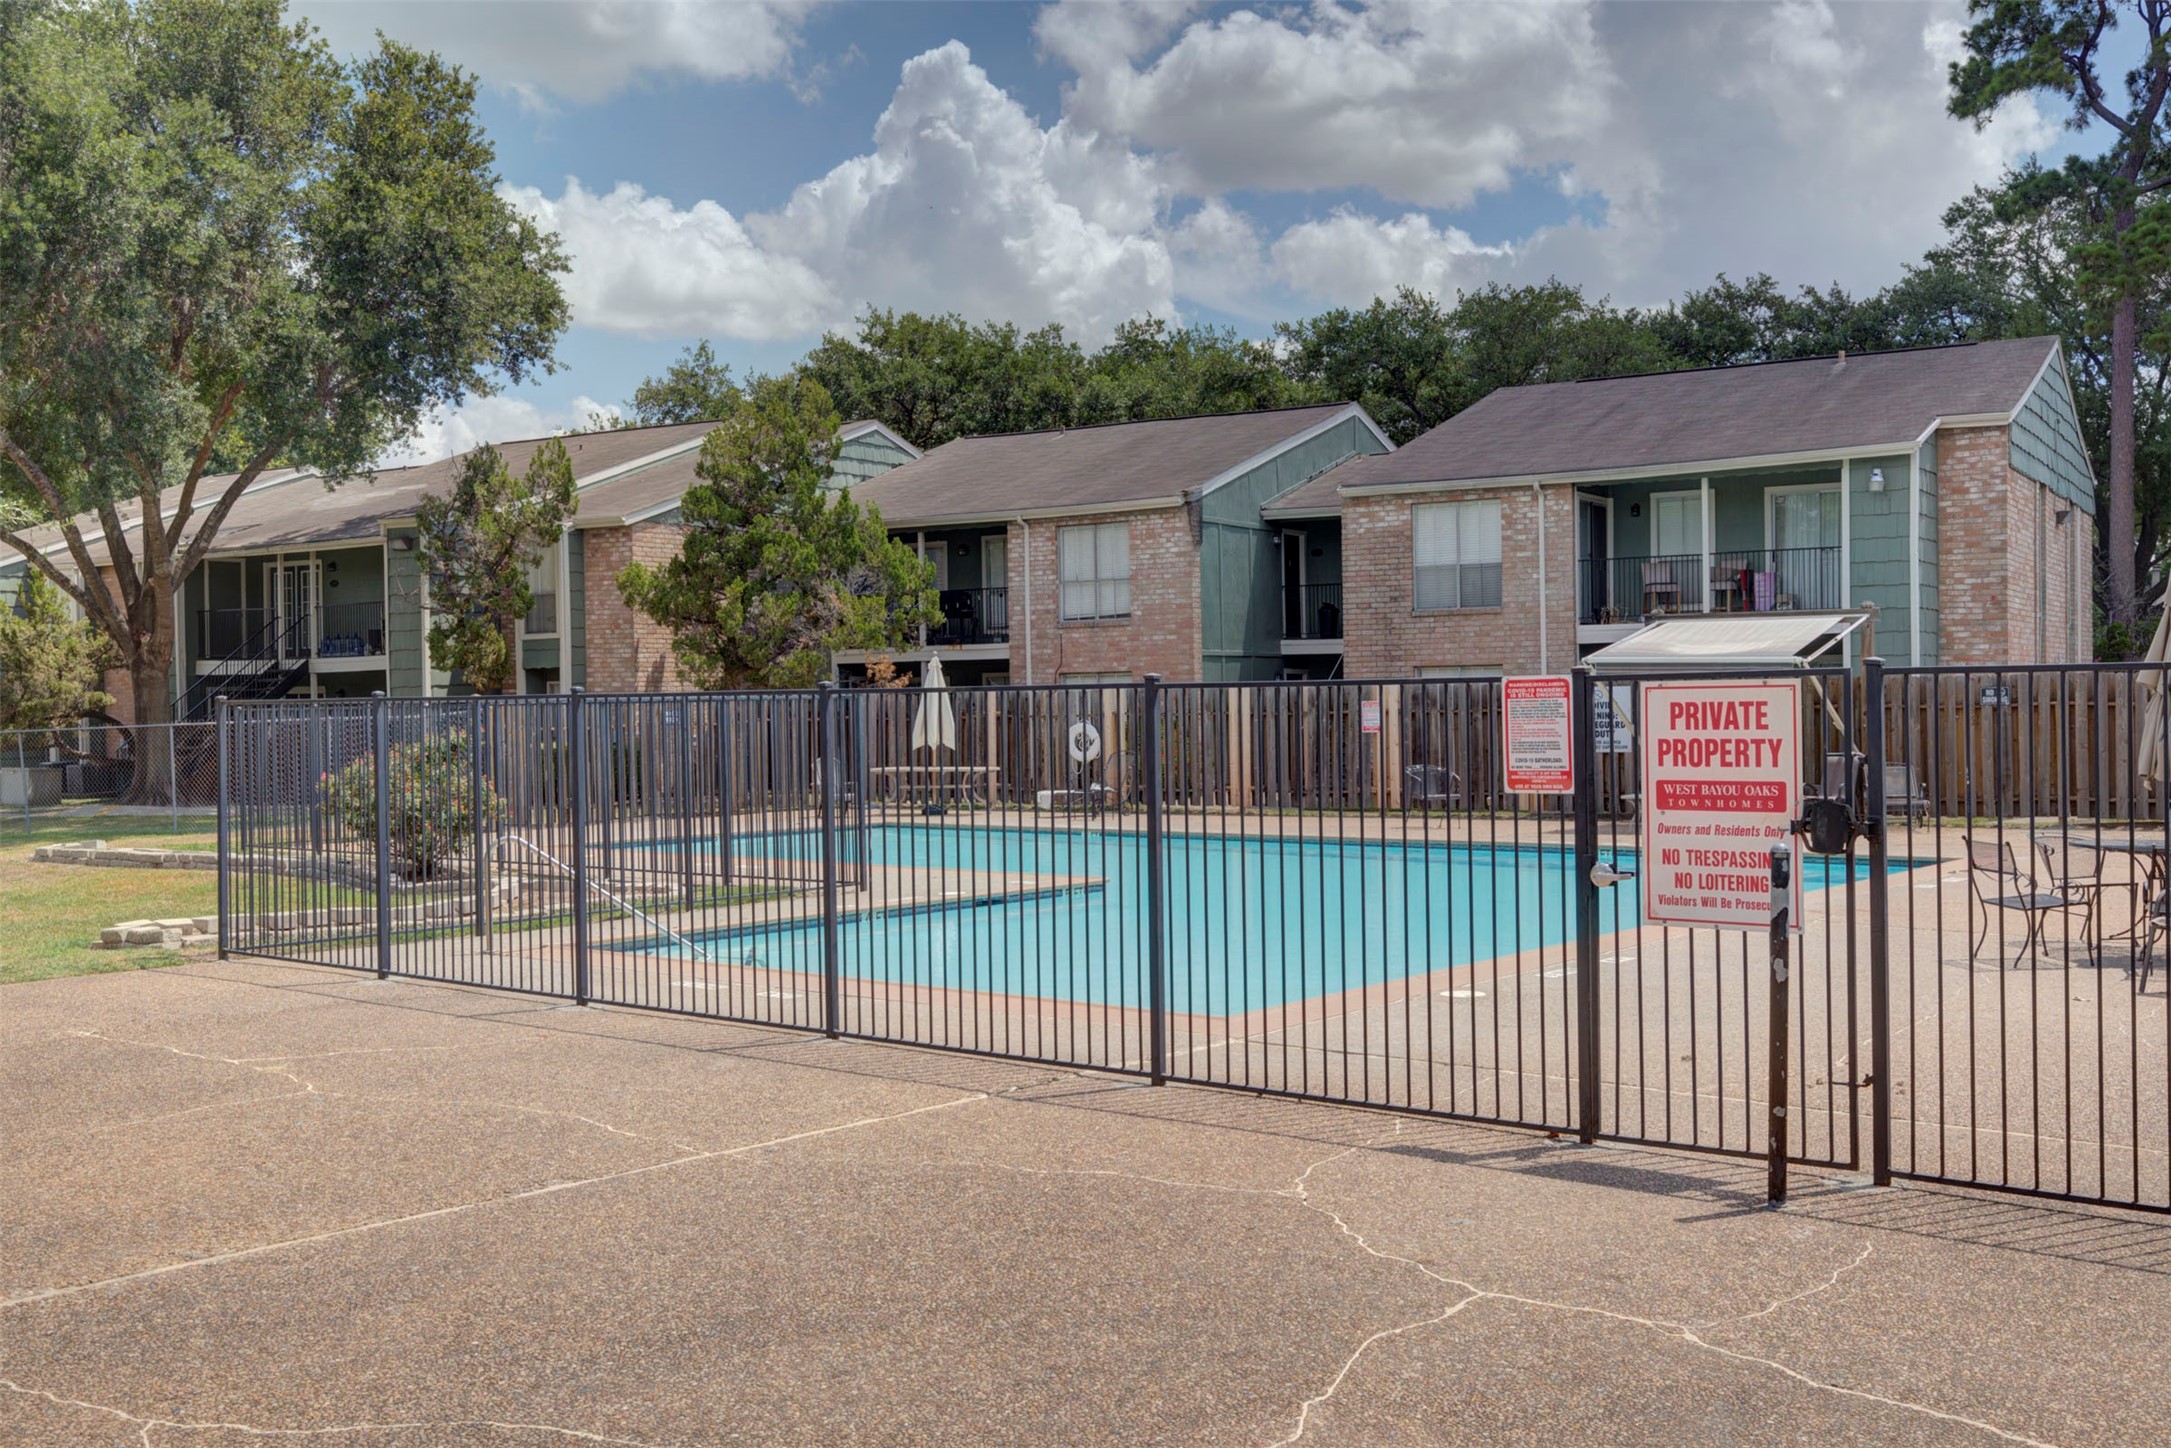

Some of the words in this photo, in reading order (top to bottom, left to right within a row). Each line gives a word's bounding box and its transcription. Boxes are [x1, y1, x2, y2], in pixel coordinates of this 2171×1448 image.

[1670, 701, 1769, 730] PRIVATE
[1658, 738, 1783, 768] PROPERTY
[1664, 784, 1698, 795] WEST
[1701, 784, 1741, 796] BAYOU
[1744, 785, 1779, 796] OAKS
[1668, 798, 1774, 809] TOWNHOMES
[1658, 823, 1691, 835] Owners
[1695, 824, 1711, 835] and
[1714, 824, 1761, 837] Residents
[1764, 826, 1785, 839] Only
[1662, 848, 1680, 865] NO
[1686, 849, 1772, 869] TRESPASSIN
[1675, 872, 1692, 889] NO
[1699, 873, 1769, 893] LOITERING
[1658, 894, 1697, 907] Violators
[1701, 896, 1717, 908] Will
[1721, 898, 1732, 909] Be
[1736, 899, 1771, 911] Prosecu
